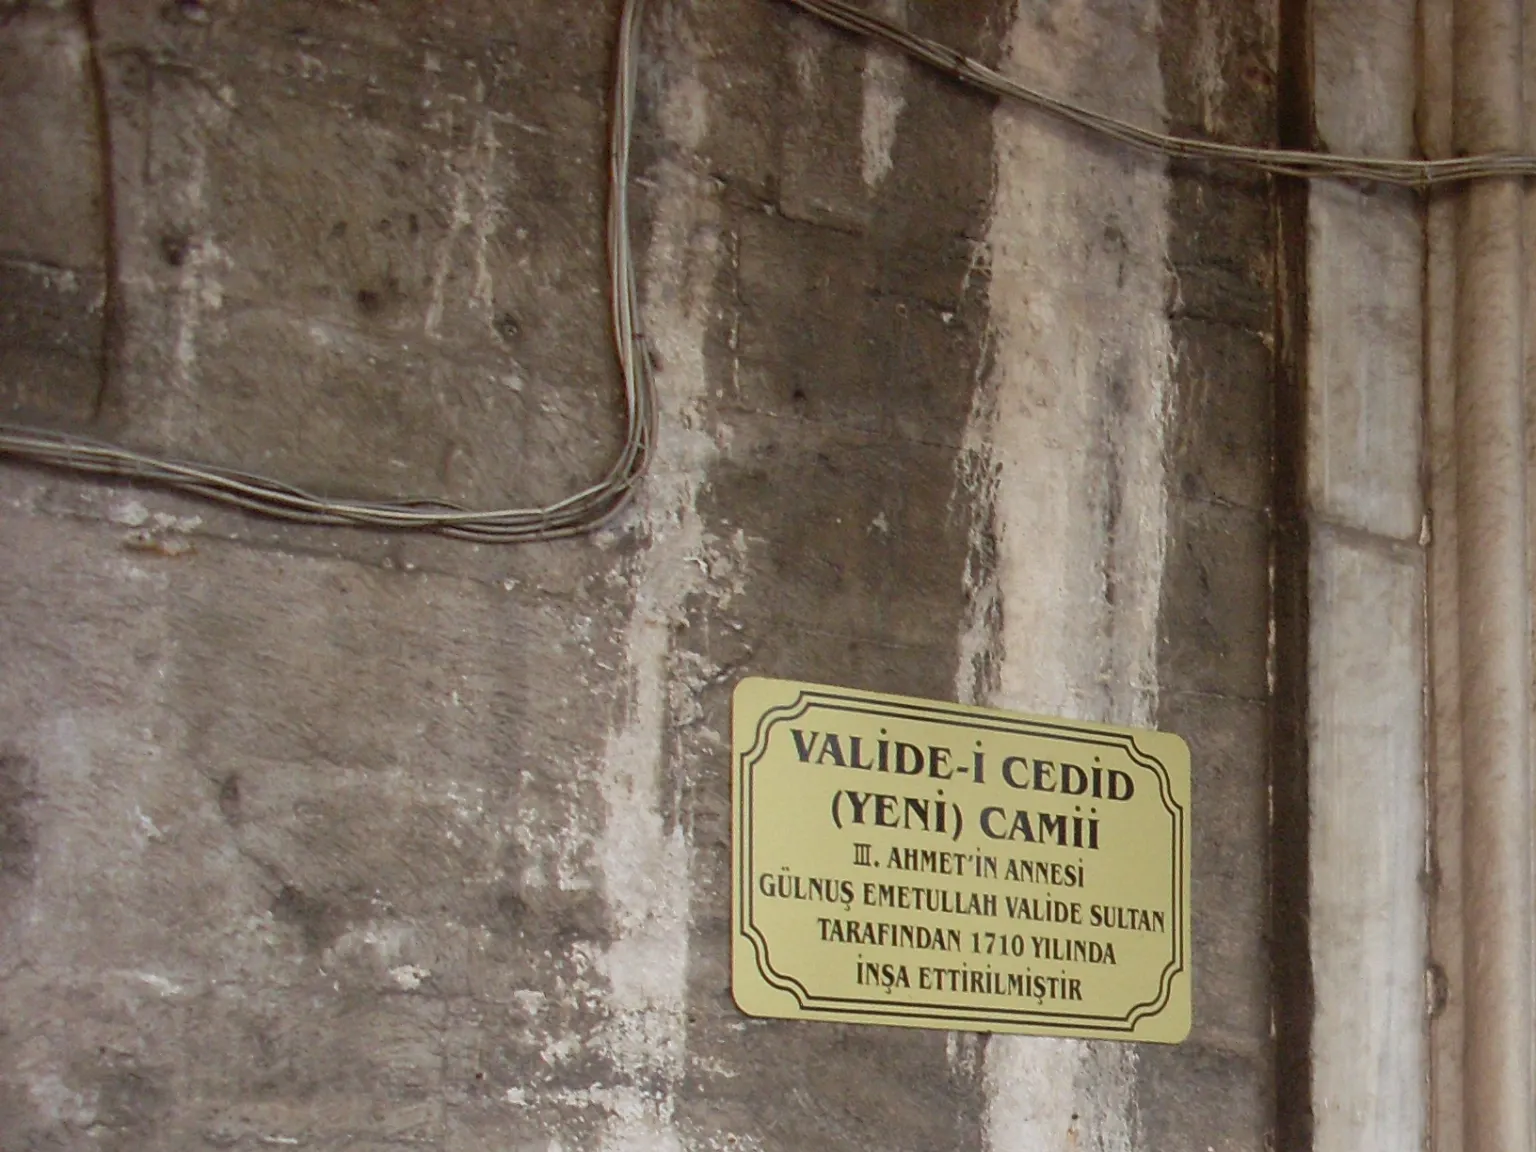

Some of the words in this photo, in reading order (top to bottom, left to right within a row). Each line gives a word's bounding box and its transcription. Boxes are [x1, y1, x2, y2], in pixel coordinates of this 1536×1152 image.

[789, 728, 985, 784] VALİDE-İ
[1002, 756, 1135, 801] CEDİD
[831, 789, 963, 841] (YENİ)
[980, 805, 1099, 849] CAMİİ
[759, 866, 854, 910] GÜLNUŞ
[863, 884, 997, 917] EMETULLAH
[1005, 892, 1082, 925] VALİDE
[1089, 907, 1165, 933] SULTAN
[1004, 857, 1084, 888] ANNESİ
[818, 917, 960, 952] TARAFINDAN
[971, 931, 1025, 957] 1710
[1031, 936, 1116, 965] YILINDA
[856, 953, 910, 996] İNŞA
[918, 961, 1083, 1005] ETTİRİLMİŞTİR
